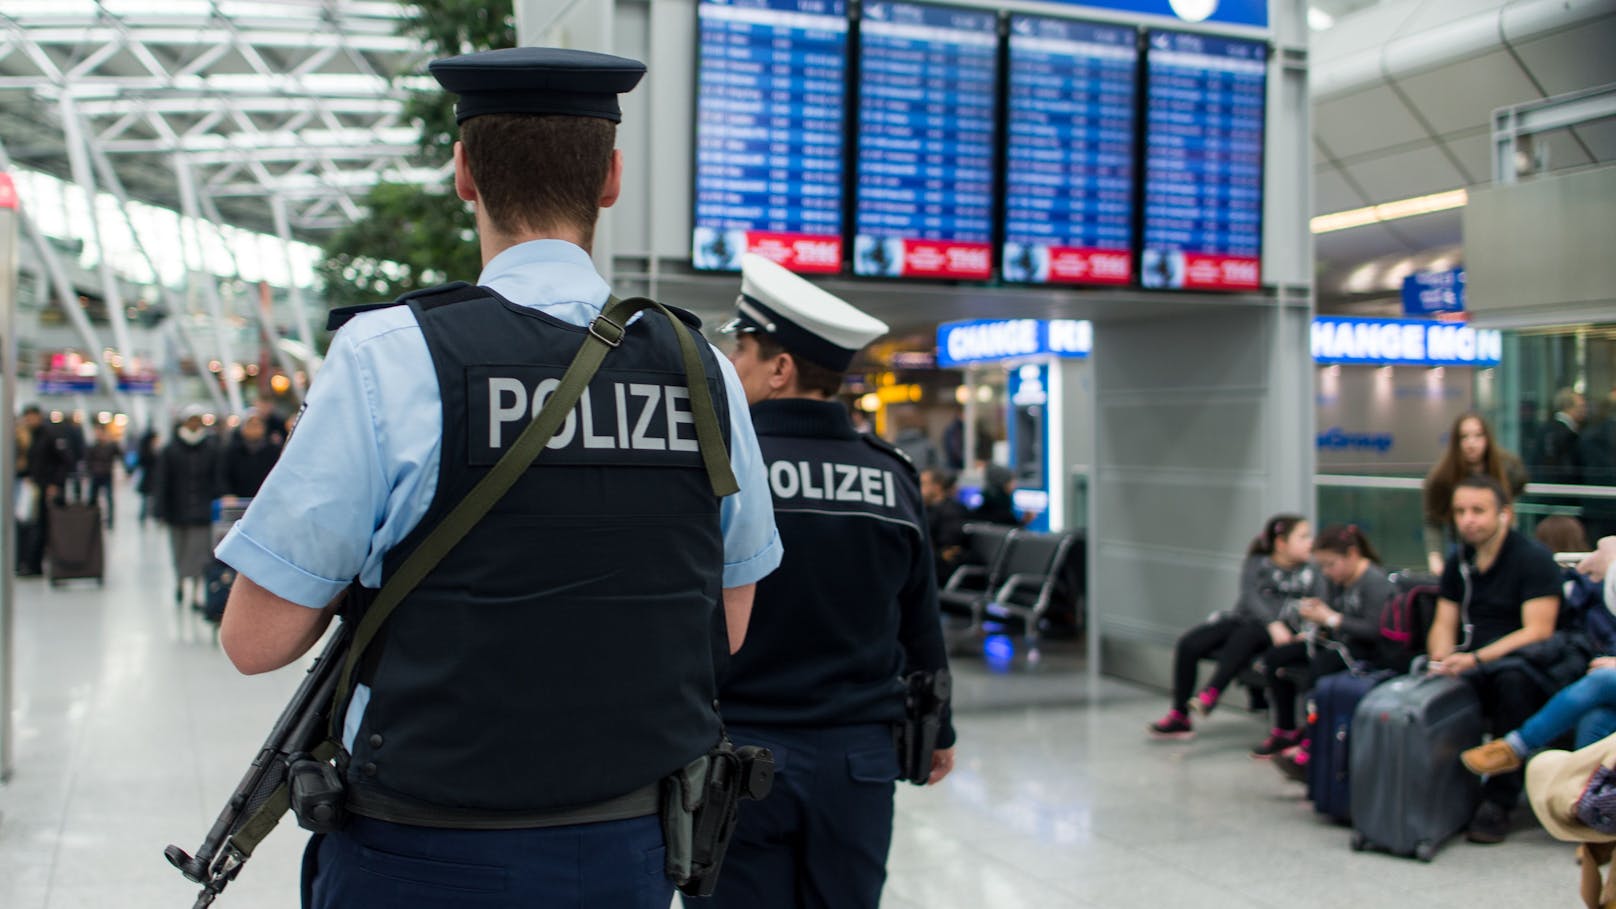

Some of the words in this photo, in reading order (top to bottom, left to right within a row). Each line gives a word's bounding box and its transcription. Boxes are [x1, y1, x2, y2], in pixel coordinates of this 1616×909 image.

[948, 319, 1037, 361] CHANGE
[1311, 321, 1425, 360] HANGE
[1427, 325, 1502, 361] MON
[488, 377, 700, 452] POLIZE
[769, 460, 896, 507] OLIZEI
